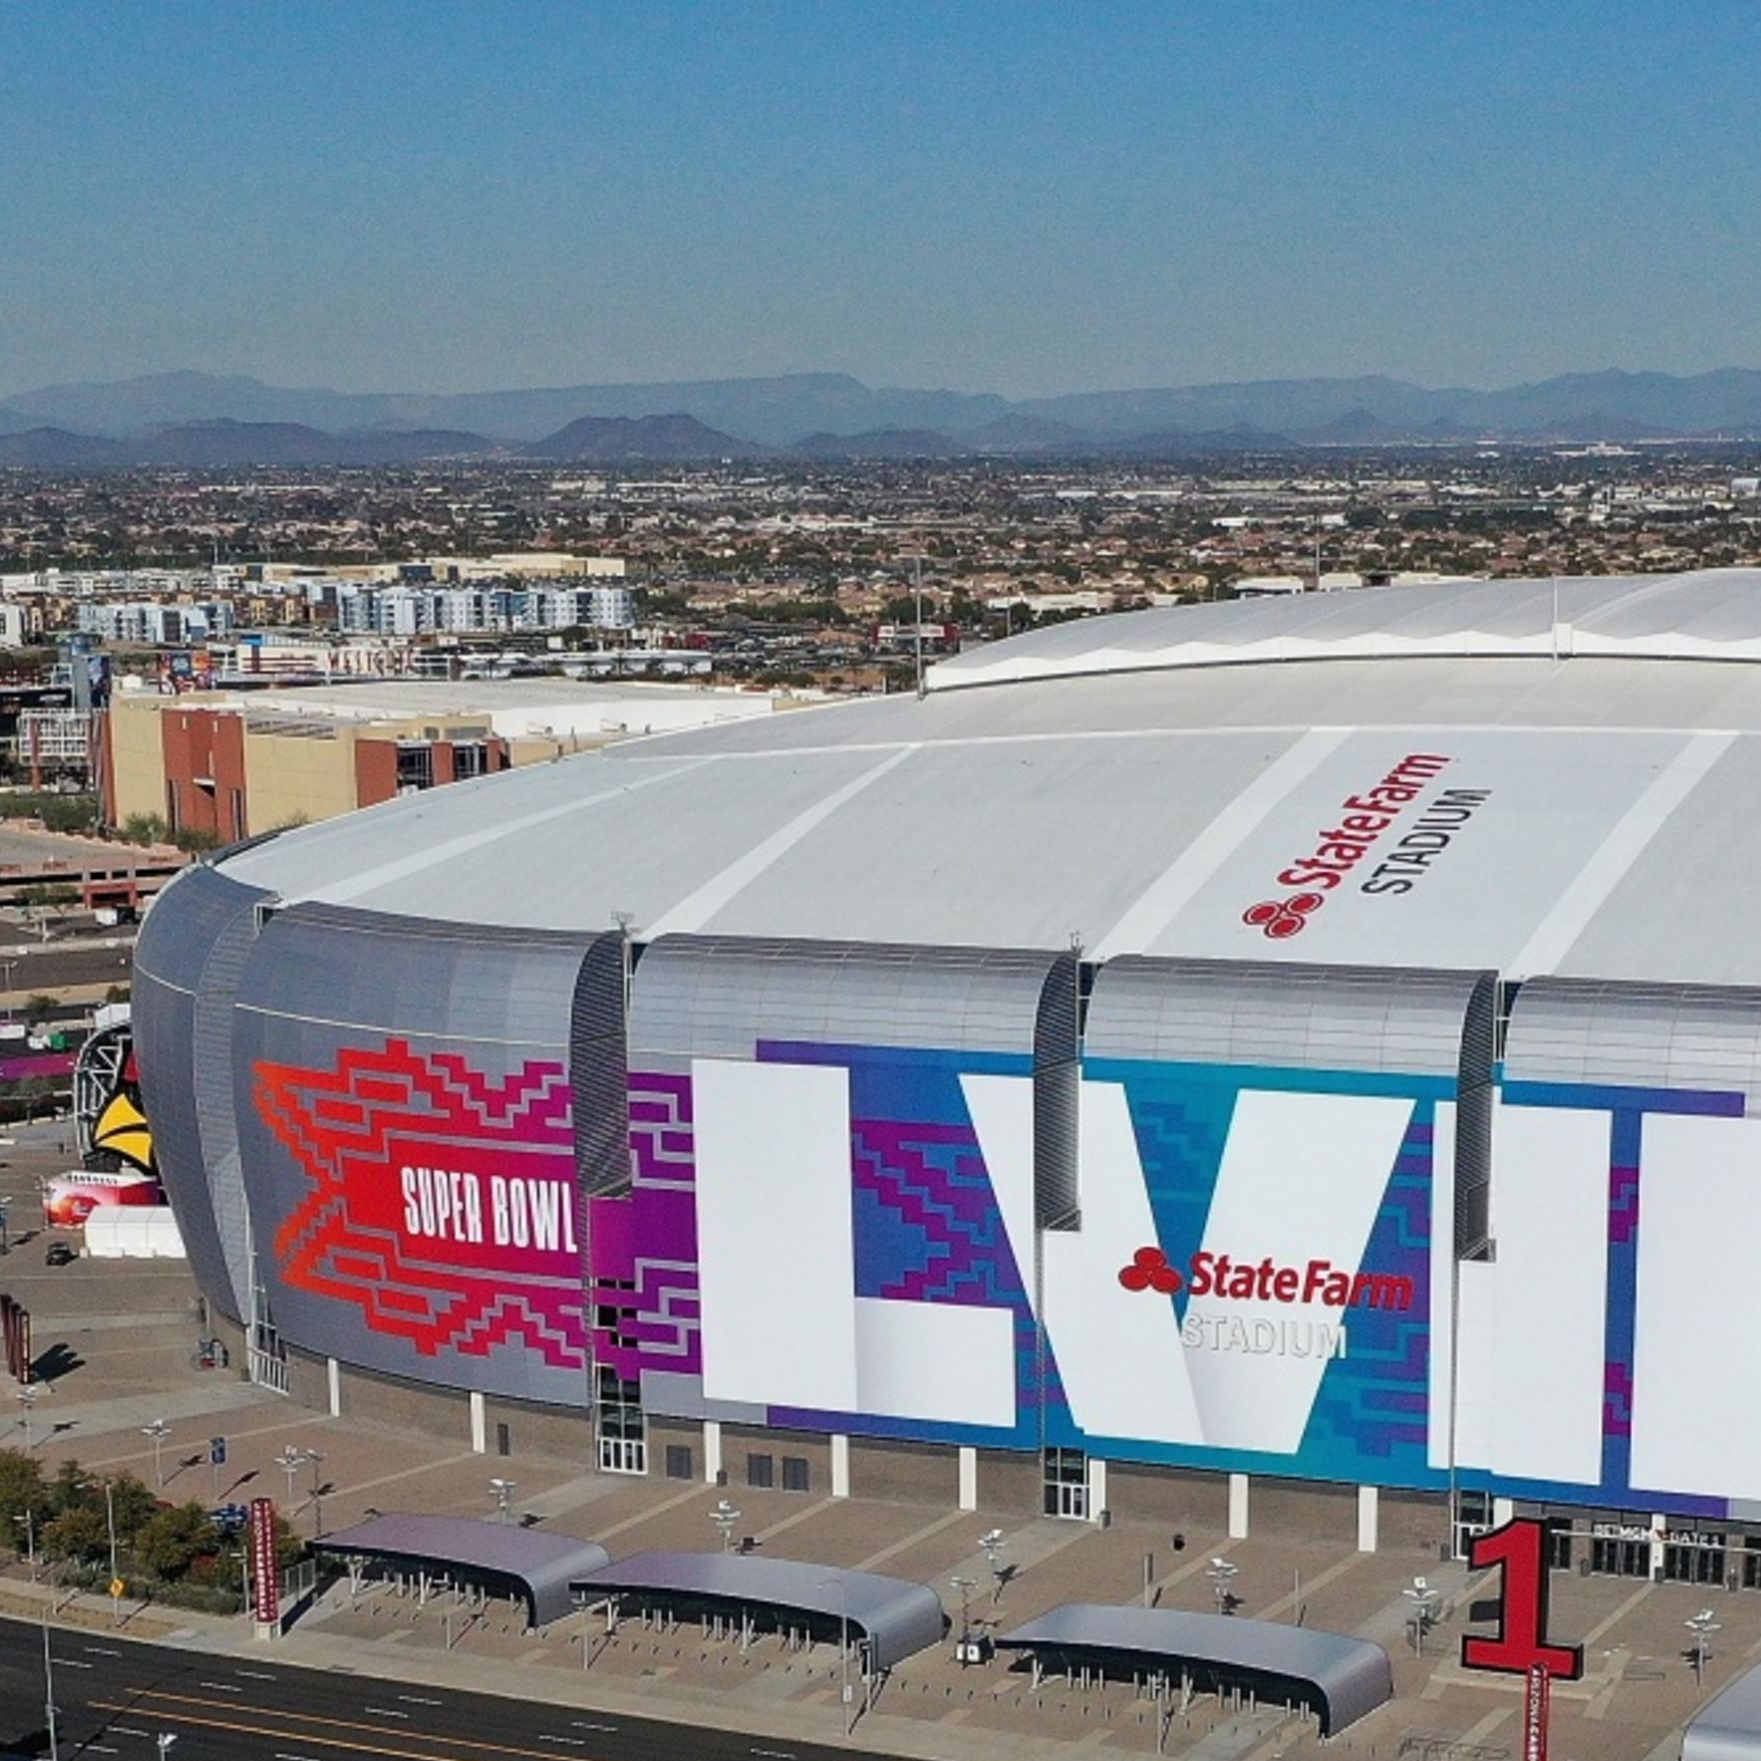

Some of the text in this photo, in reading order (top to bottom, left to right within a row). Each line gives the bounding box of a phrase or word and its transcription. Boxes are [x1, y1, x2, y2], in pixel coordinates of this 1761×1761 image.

[1360, 788, 1493, 895] STADIUM
[400, 1166, 579, 1254] SUPER BOWL
[1180, 1311, 1347, 1360] STADIUM
[1462, 1516, 1582, 1680] 1
